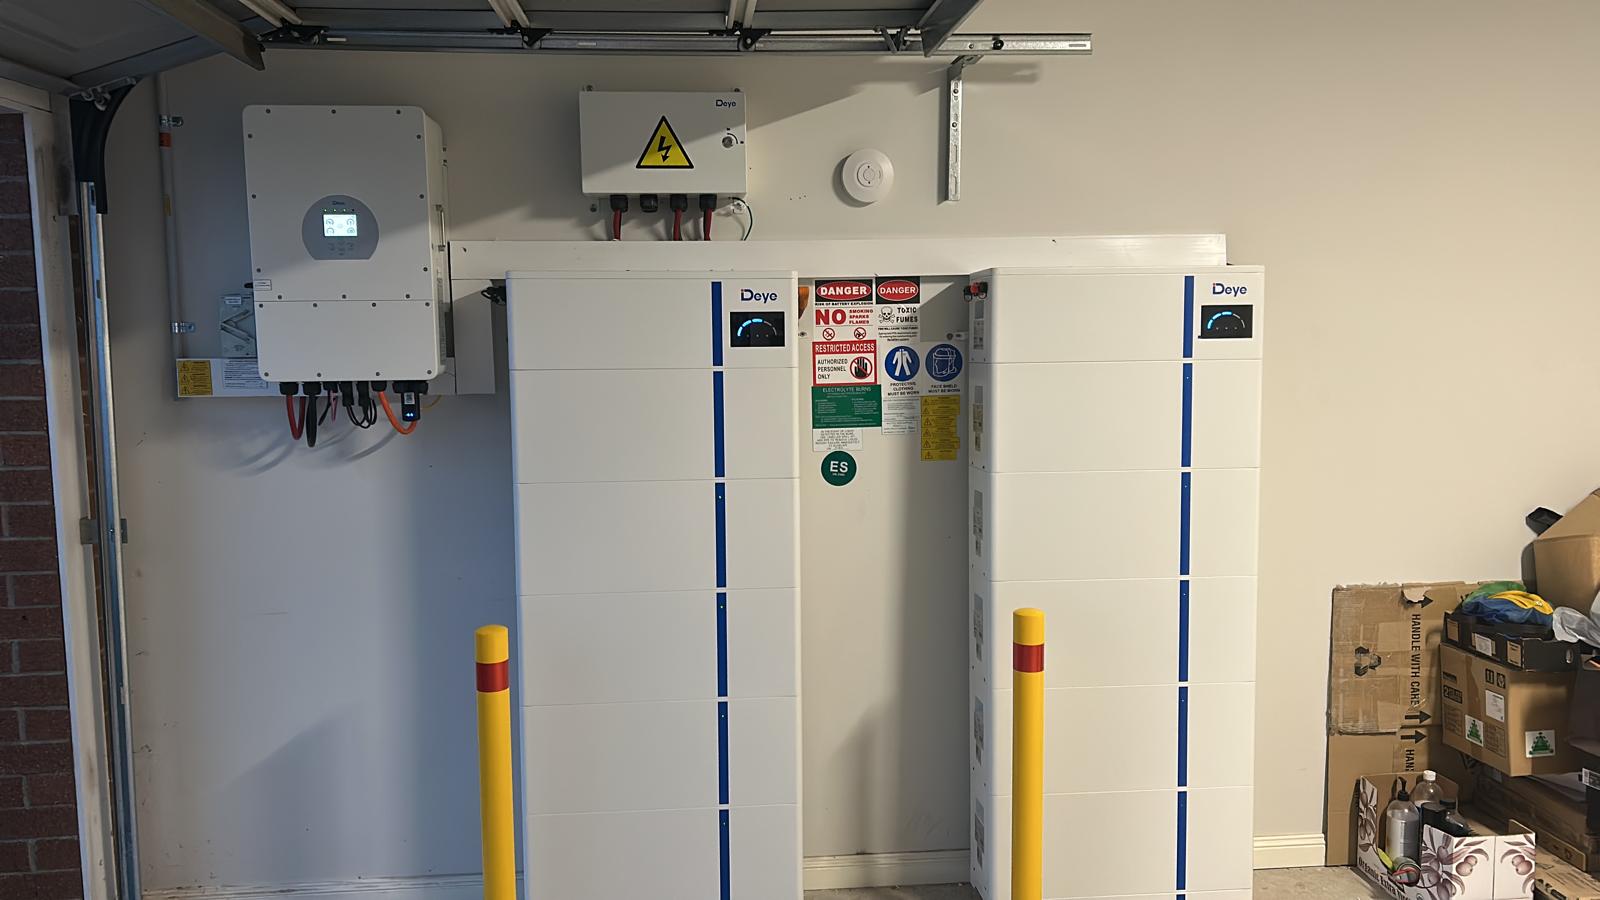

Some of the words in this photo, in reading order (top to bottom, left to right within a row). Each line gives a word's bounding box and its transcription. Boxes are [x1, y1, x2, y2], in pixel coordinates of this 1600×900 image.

[716, 99, 736, 108] Deye
[741, 289, 777, 303] Deye
[820, 286, 867, 296] DANGER
[880, 286, 916, 294] DANGER
[1212, 283, 1247, 297] Deye
[816, 309, 846, 325] NO
[815, 344, 850, 352] RESTRICTED
[852, 343, 874, 352] ACCESS
[830, 460, 848, 473] ES
[1412, 614, 1421, 651] HANDLE
[1411, 654, 1420, 677] WITH
[1410, 681, 1420, 705] CARE
[1359, 856, 1379, 882] Organic
